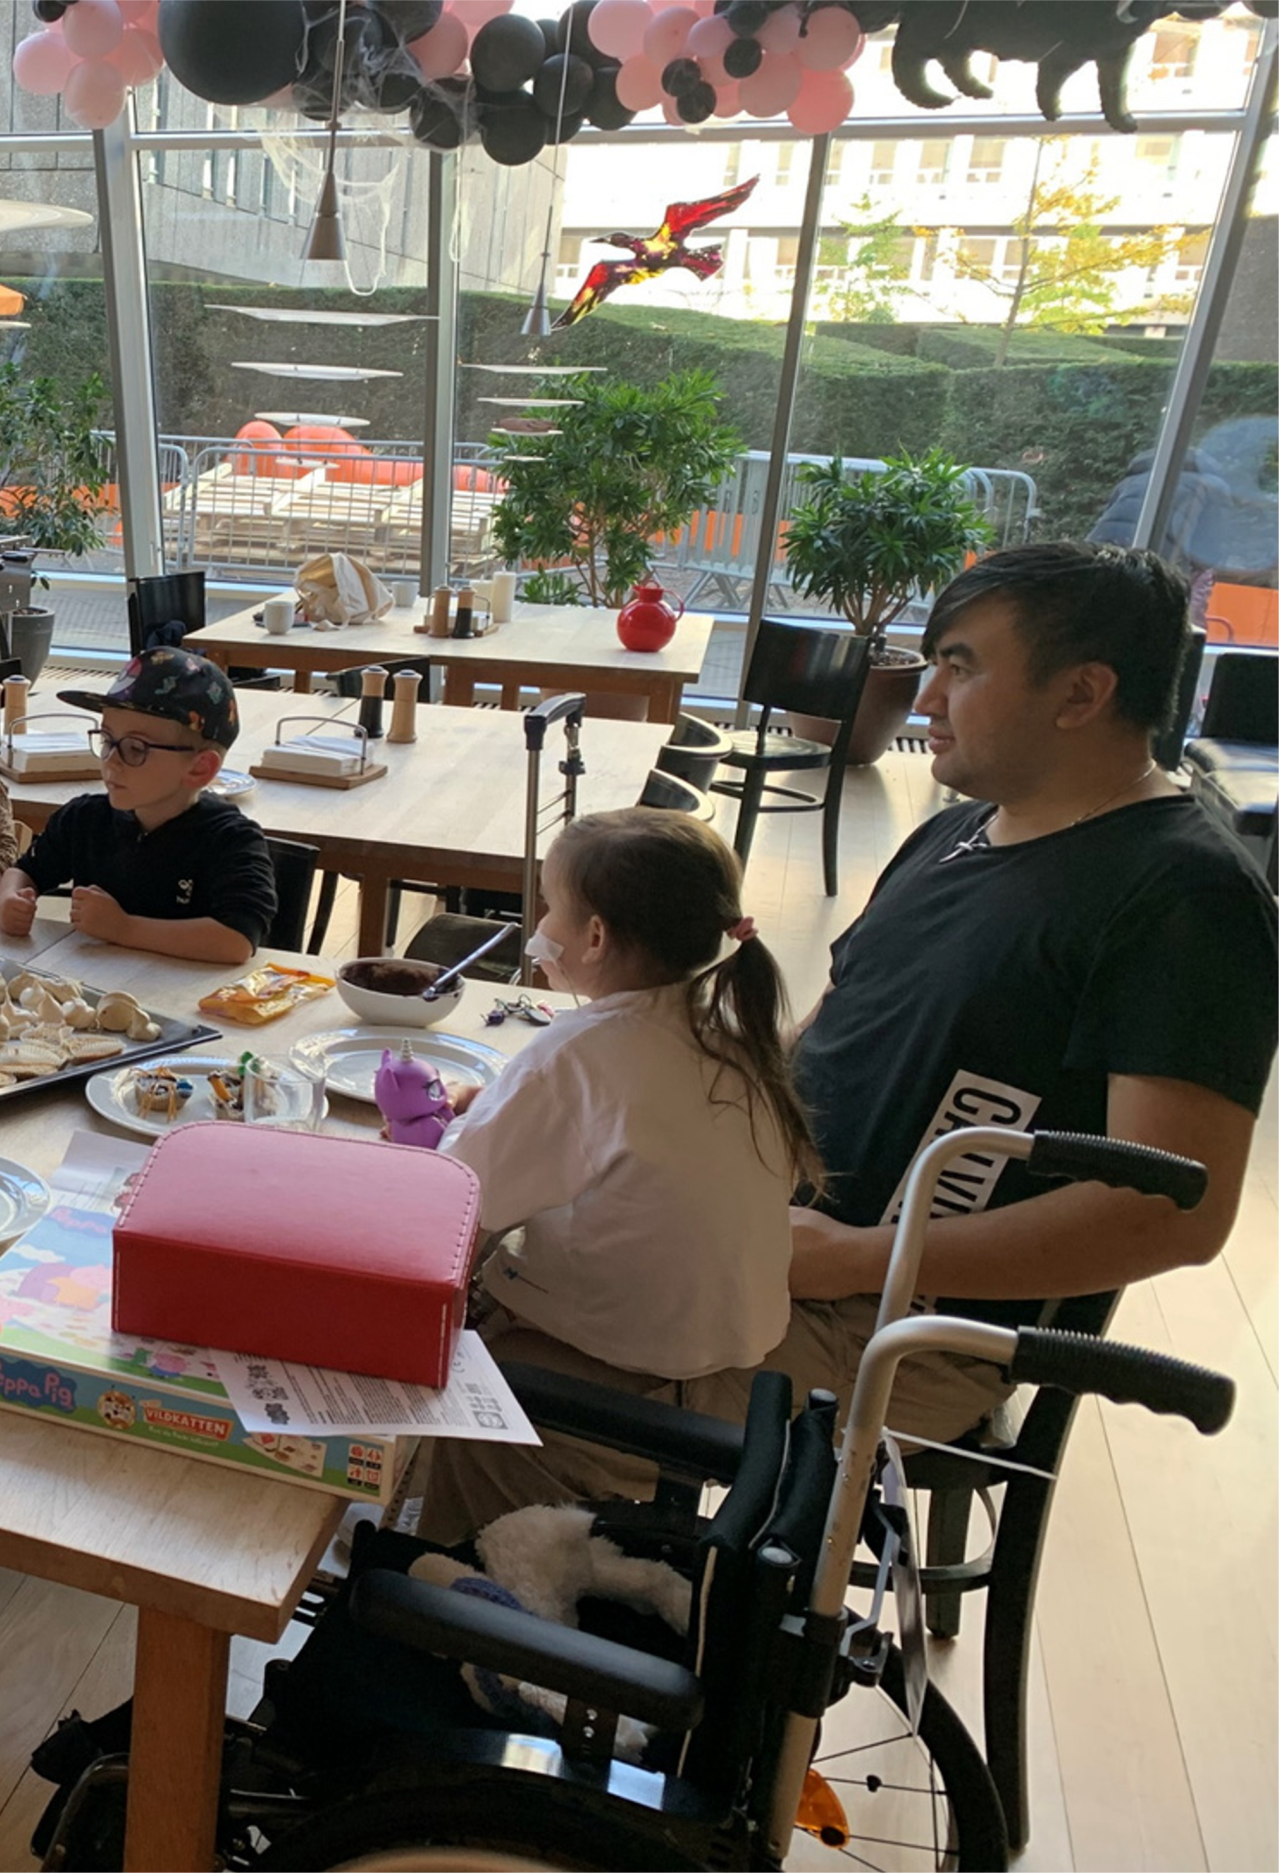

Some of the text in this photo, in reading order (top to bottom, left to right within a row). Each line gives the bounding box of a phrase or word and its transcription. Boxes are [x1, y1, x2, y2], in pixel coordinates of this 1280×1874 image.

[890, 1086, 1023, 1224] CVI
[44, 1372, 74, 1410] Pig
[146, 1408, 226, 1435] VILDKATTEN
